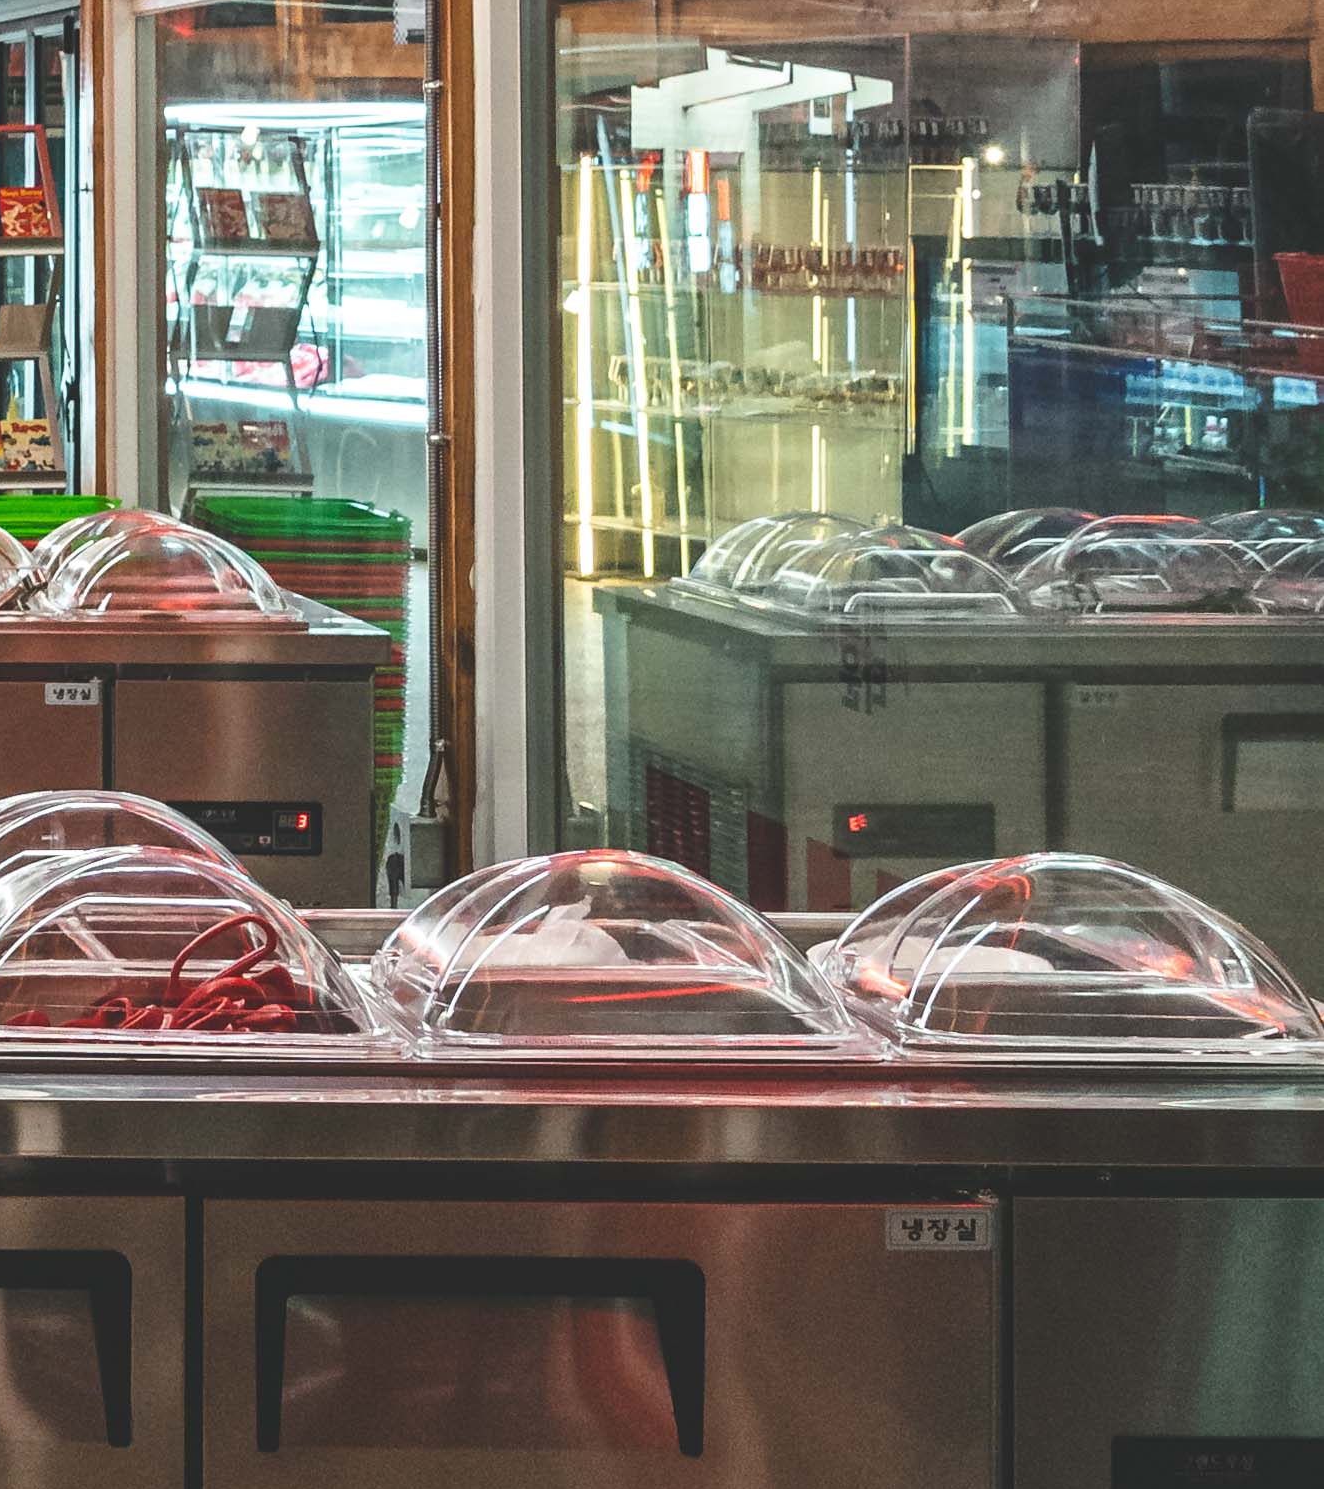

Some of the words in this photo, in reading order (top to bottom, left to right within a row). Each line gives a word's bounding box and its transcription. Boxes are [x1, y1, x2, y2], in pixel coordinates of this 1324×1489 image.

[53, 688, 91, 701] 냉장실
[297, 813, 308, 829] 3
[901, 1218, 976, 1241] 냉장실
